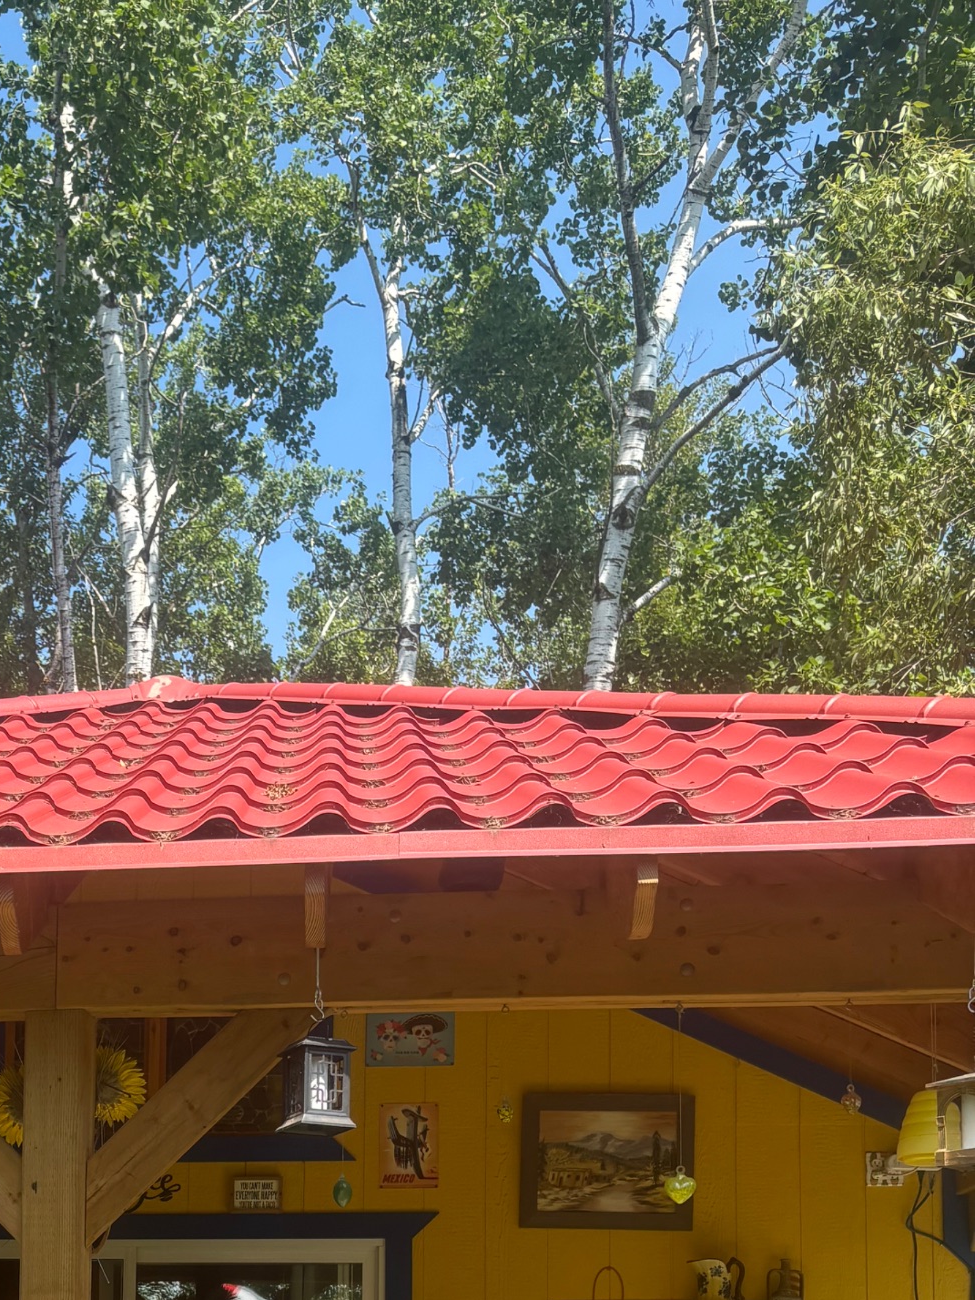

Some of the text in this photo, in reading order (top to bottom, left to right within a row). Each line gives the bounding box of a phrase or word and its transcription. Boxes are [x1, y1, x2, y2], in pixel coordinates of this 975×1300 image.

[383, 1174, 415, 1184] MEXICO
[235, 1191, 278, 1200] EVERYONE HAPPY
